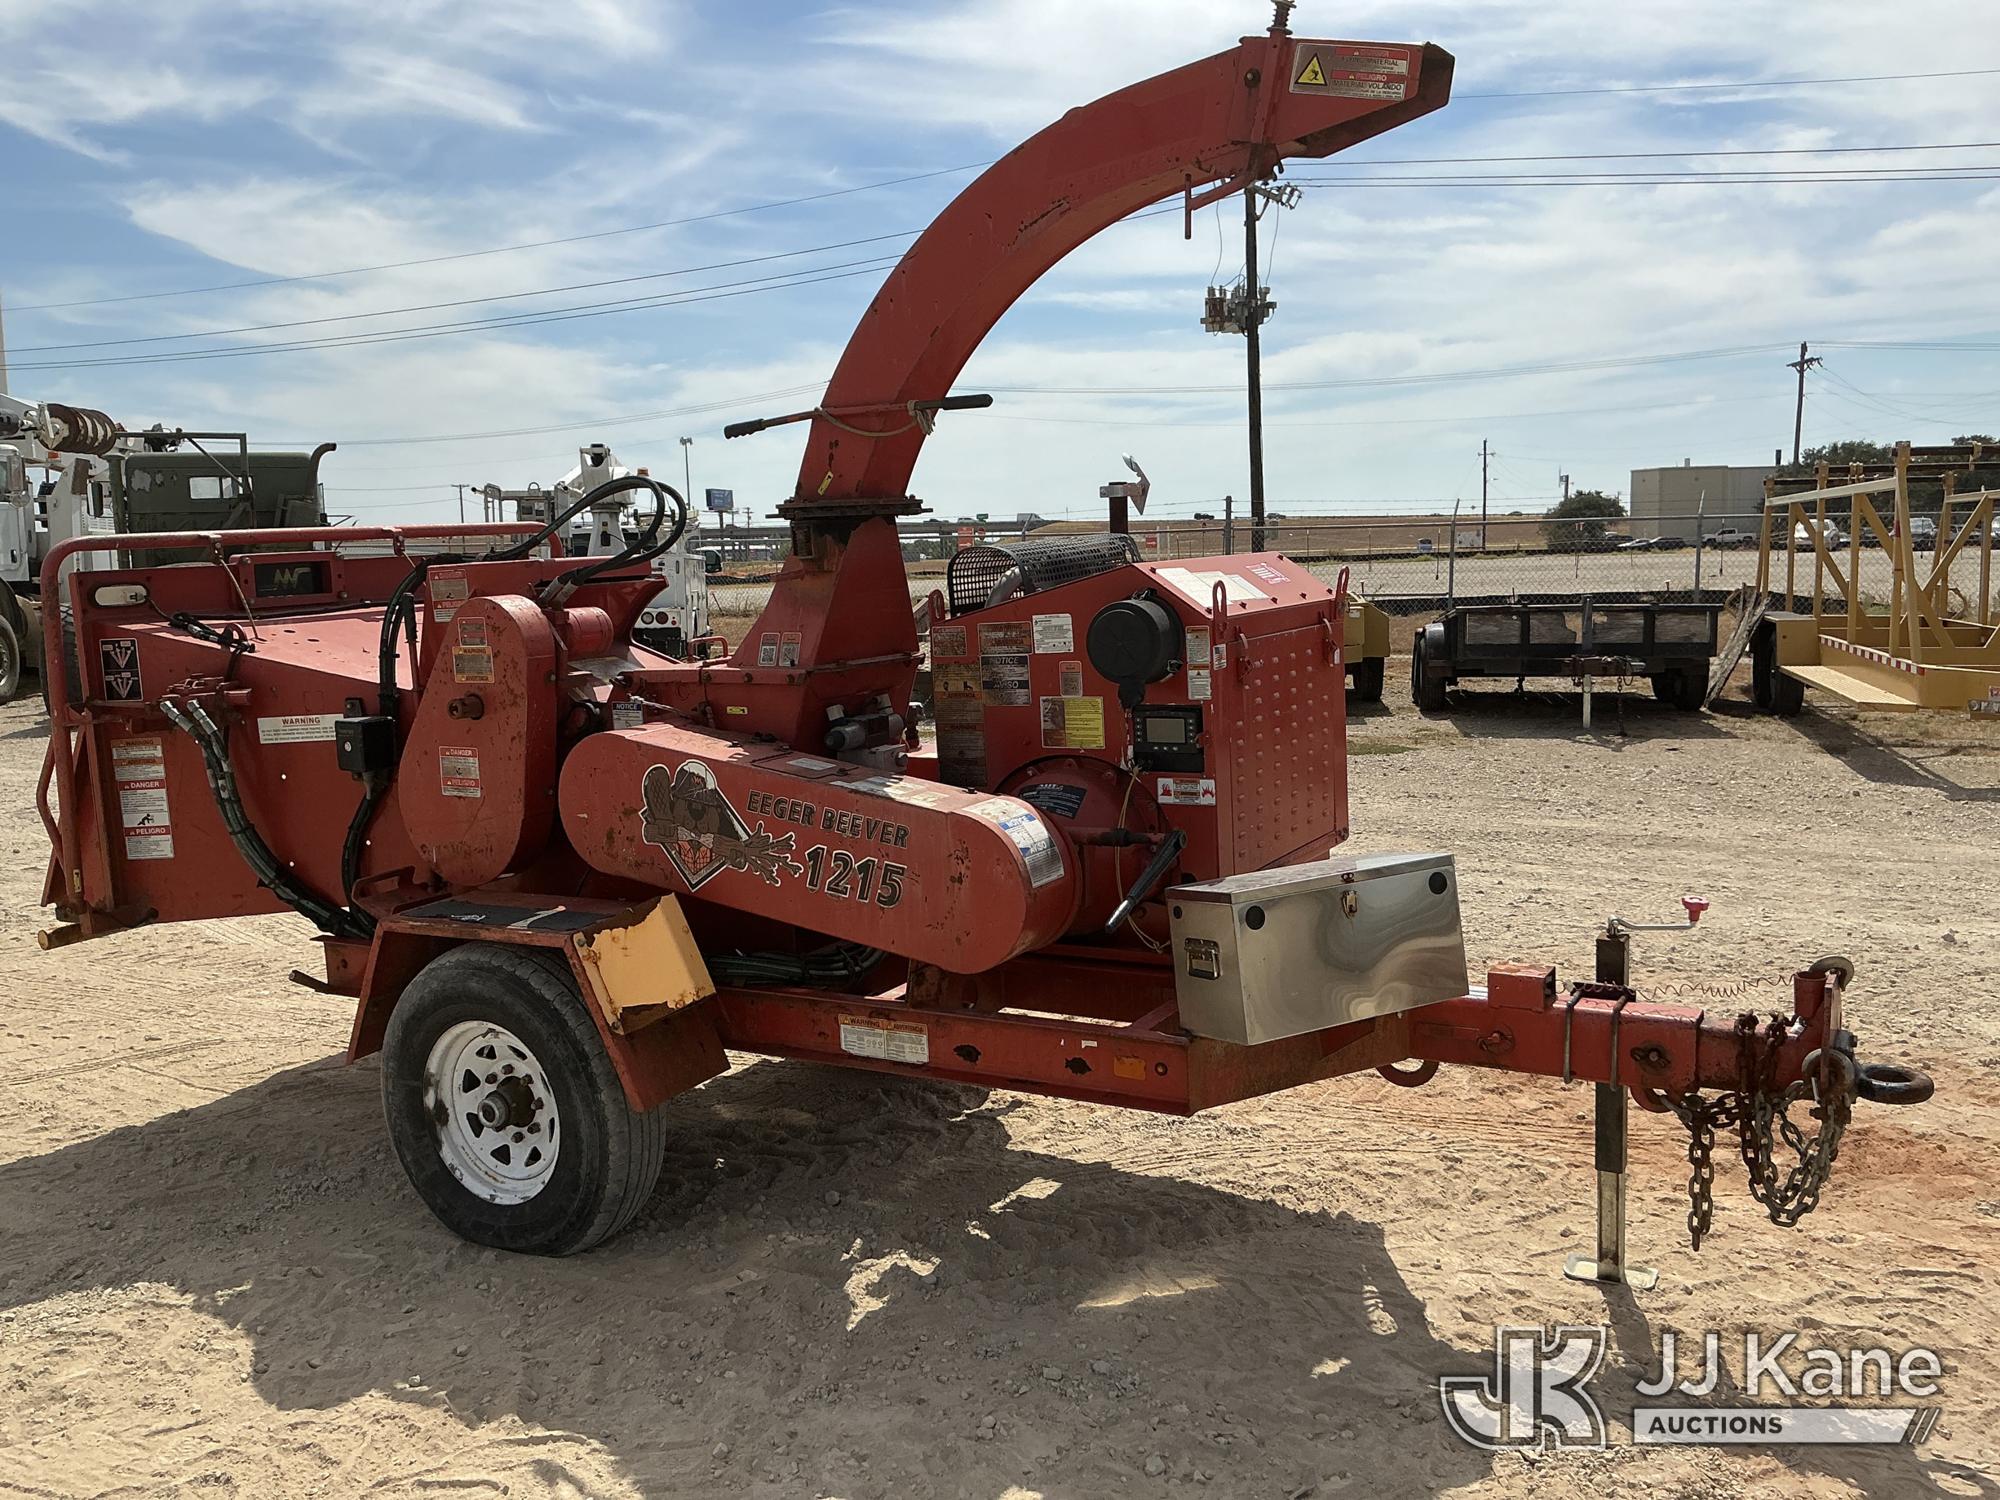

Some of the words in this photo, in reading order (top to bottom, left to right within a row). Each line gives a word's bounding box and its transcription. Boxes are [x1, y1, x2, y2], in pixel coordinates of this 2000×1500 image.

[1367, 82, 1402, 91] VOLANDO
[991, 656, 1019, 665] OTICE
[616, 702, 638, 711] NOTICE
[282, 716, 321, 726] WARNING
[130, 780, 160, 790] DANGER
[136, 827, 166, 836] PELIGRO
[820, 806, 911, 848] BEEVER
[805, 844, 908, 909] 1215
